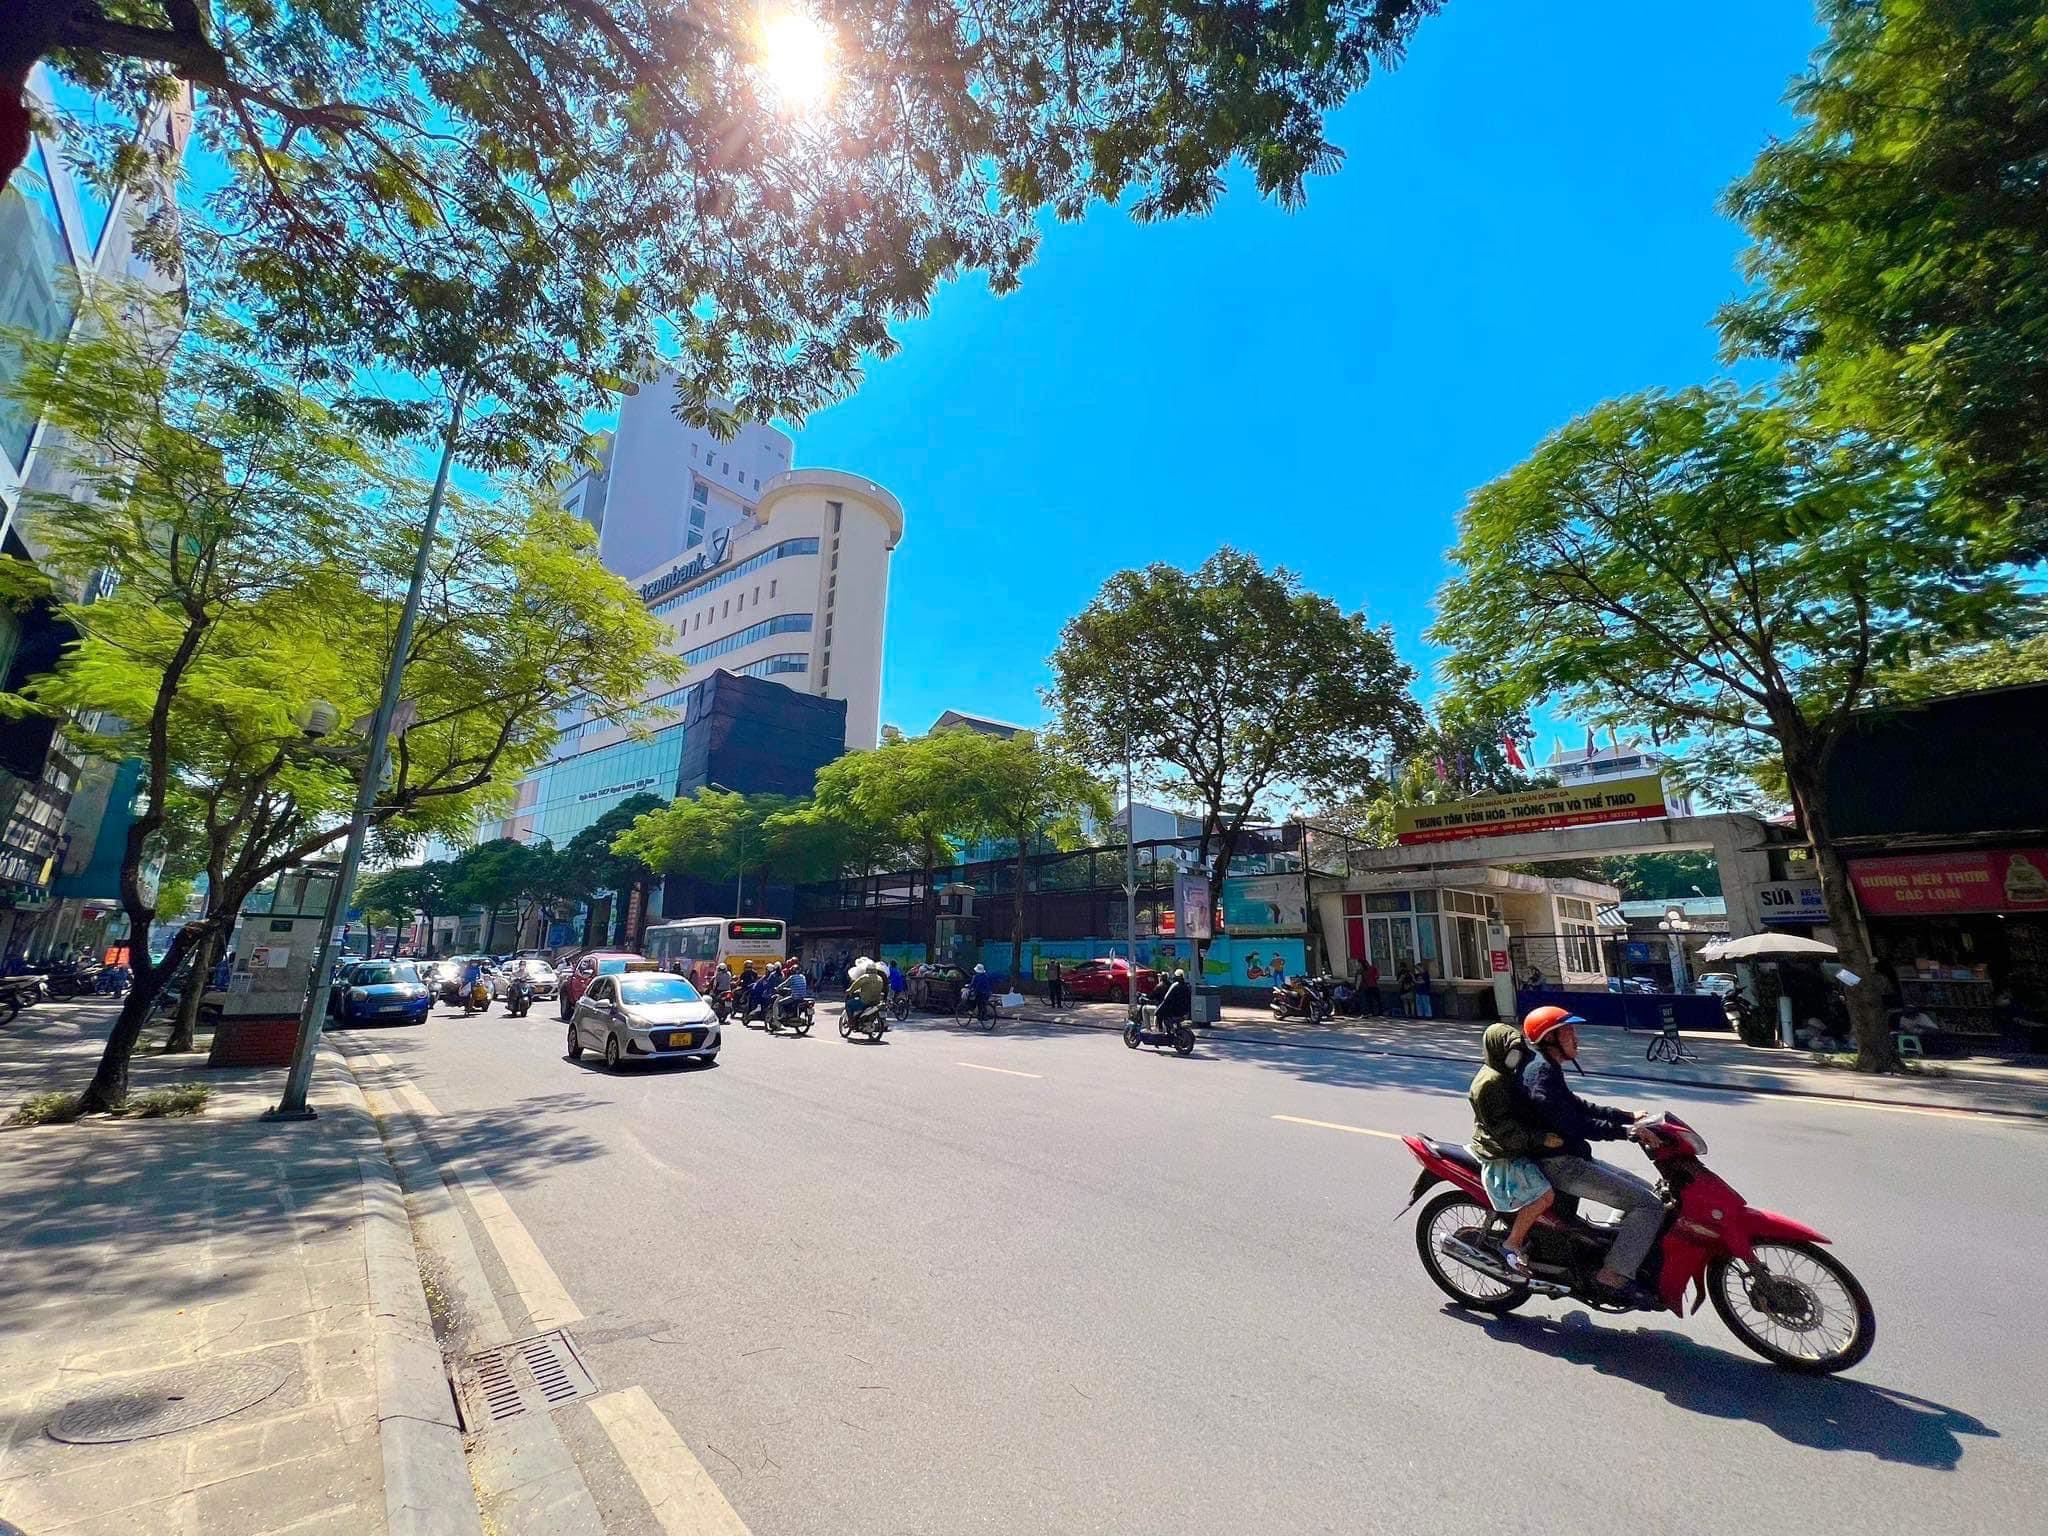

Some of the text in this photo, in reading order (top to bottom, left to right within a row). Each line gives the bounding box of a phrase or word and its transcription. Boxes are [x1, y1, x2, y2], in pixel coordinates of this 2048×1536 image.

[1414, 816, 1442, 829] TRUNG
[1444, 813, 1464, 826] TÂM
[1512, 802, 1546, 817] THÔNG
[1547, 800, 1565, 813] TIN
[1565, 796, 1582, 811] VÀ
[1582, 791, 1604, 809] THỂ
[1604, 792, 1637, 807] THAO
